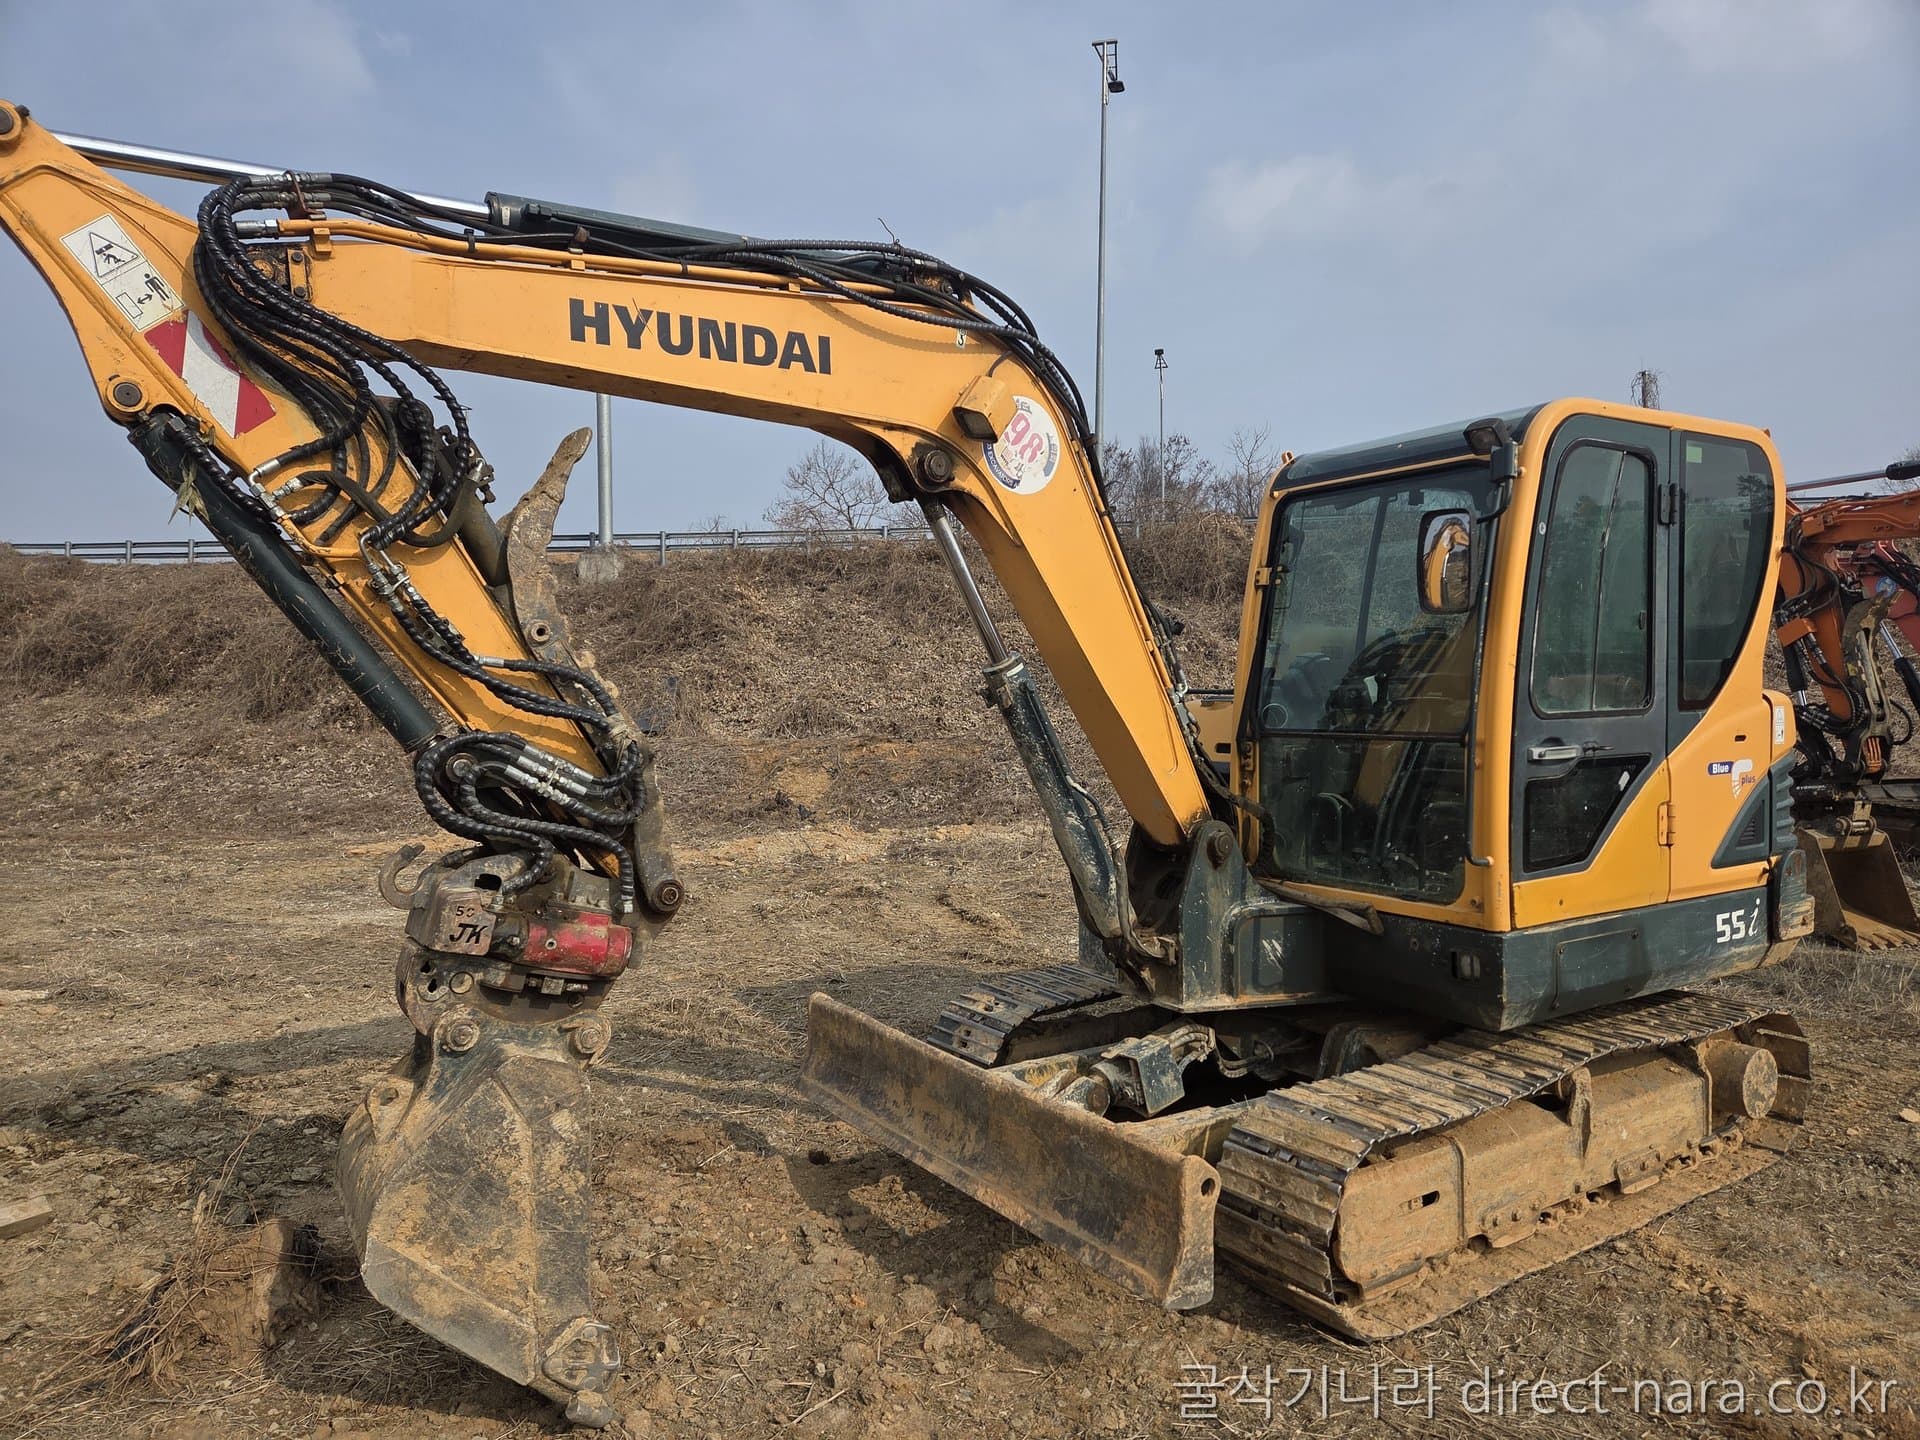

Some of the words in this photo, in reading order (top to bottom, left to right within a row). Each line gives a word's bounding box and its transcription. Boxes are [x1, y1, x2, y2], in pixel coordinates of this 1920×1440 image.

[569, 298, 832, 375] HYUNDAI
[1712, 763, 1730, 774] Blue
[1741, 775, 1756, 786] plus
[449, 923, 488, 944] JK
